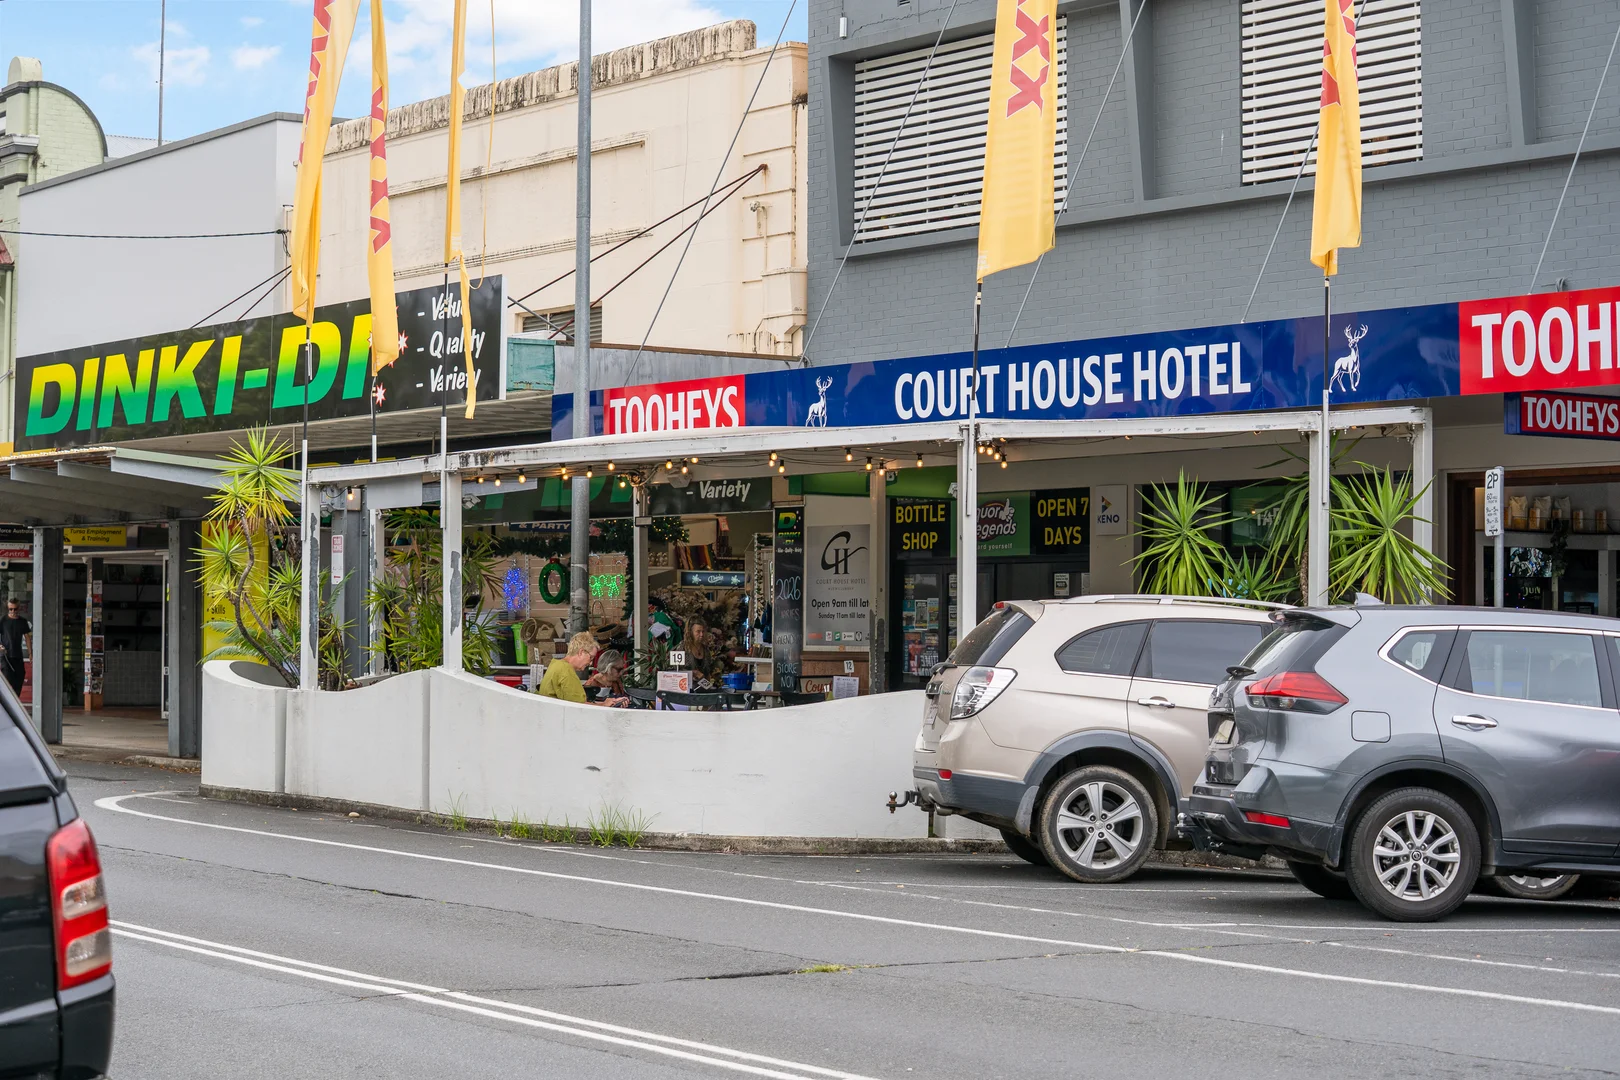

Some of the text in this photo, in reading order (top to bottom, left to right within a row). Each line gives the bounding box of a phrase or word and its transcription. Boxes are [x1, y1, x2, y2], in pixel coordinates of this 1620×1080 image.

[431, 293, 464, 321] Valu
[429, 327, 486, 359] Qualty
[1472, 301, 1620, 379] TOOH
[25, 314, 373, 437] DINKI-DI
[430, 365, 481, 393] Variey
[894, 341, 1251, 420] COURT HOUSE HOTEL
[610, 385, 740, 435] TOOHEYS
[1523, 396, 1619, 434] TOOHEYS
[1487, 473, 1499, 489] 2P
[700, 481, 751, 502] Variety
[895, 504, 946, 523] BOTTLE
[1037, 497, 1089, 518] OPEN 7
[1097, 515, 1120, 524] KENO
[87, 529, 122, 537] Employment
[976, 520, 1016, 539] egends
[1045, 526, 1082, 545] DAYS
[902, 532, 938, 550] SHOP
[776, 576, 802, 600] 2026
[211, 604, 226, 614] Skills
[811, 598, 869, 610] Open 9am till lat
[818, 612, 835, 620] Sunday
[672, 653, 683, 663] 19
[845, 661, 853, 670] 12
[777, 662, 799, 675] STORE
[781, 676, 794, 688] NO
